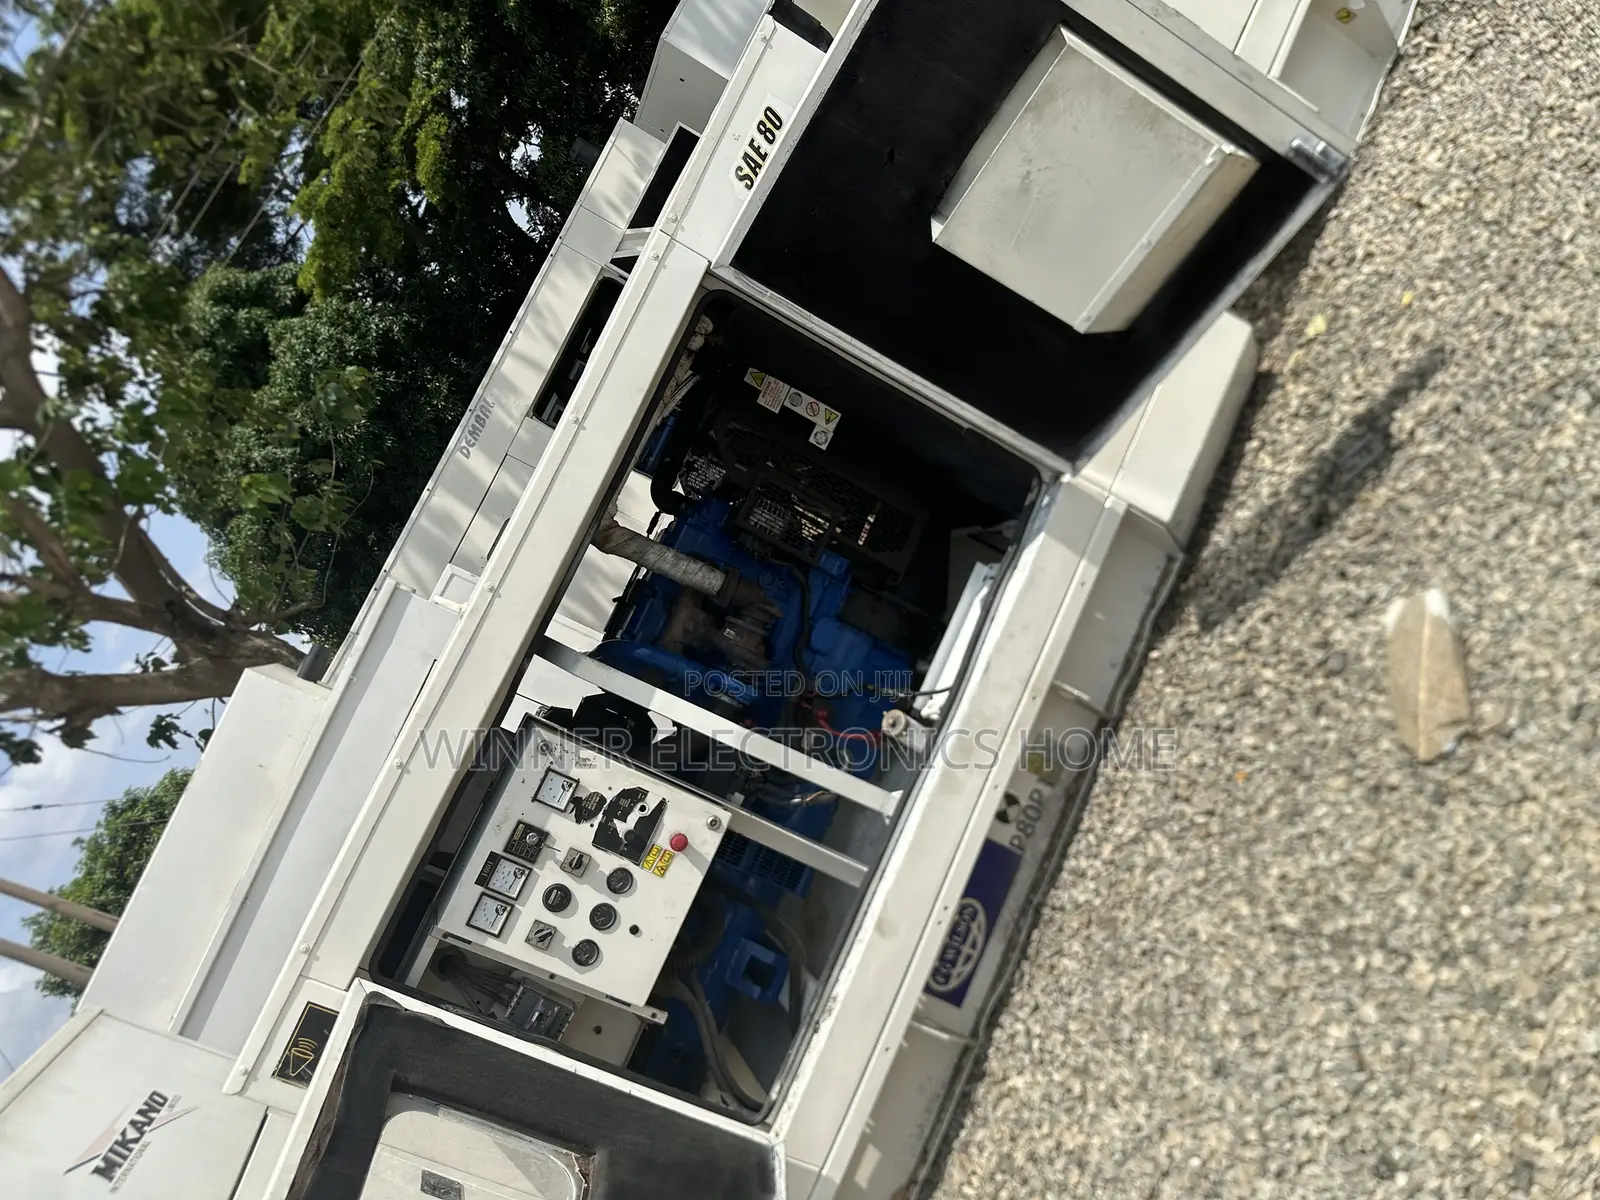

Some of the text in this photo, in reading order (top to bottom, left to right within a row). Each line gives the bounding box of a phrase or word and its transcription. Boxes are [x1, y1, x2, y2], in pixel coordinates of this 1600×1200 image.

[735, 106, 783, 190] SAE 80
[90, 1089, 169, 1183] MIKANO
